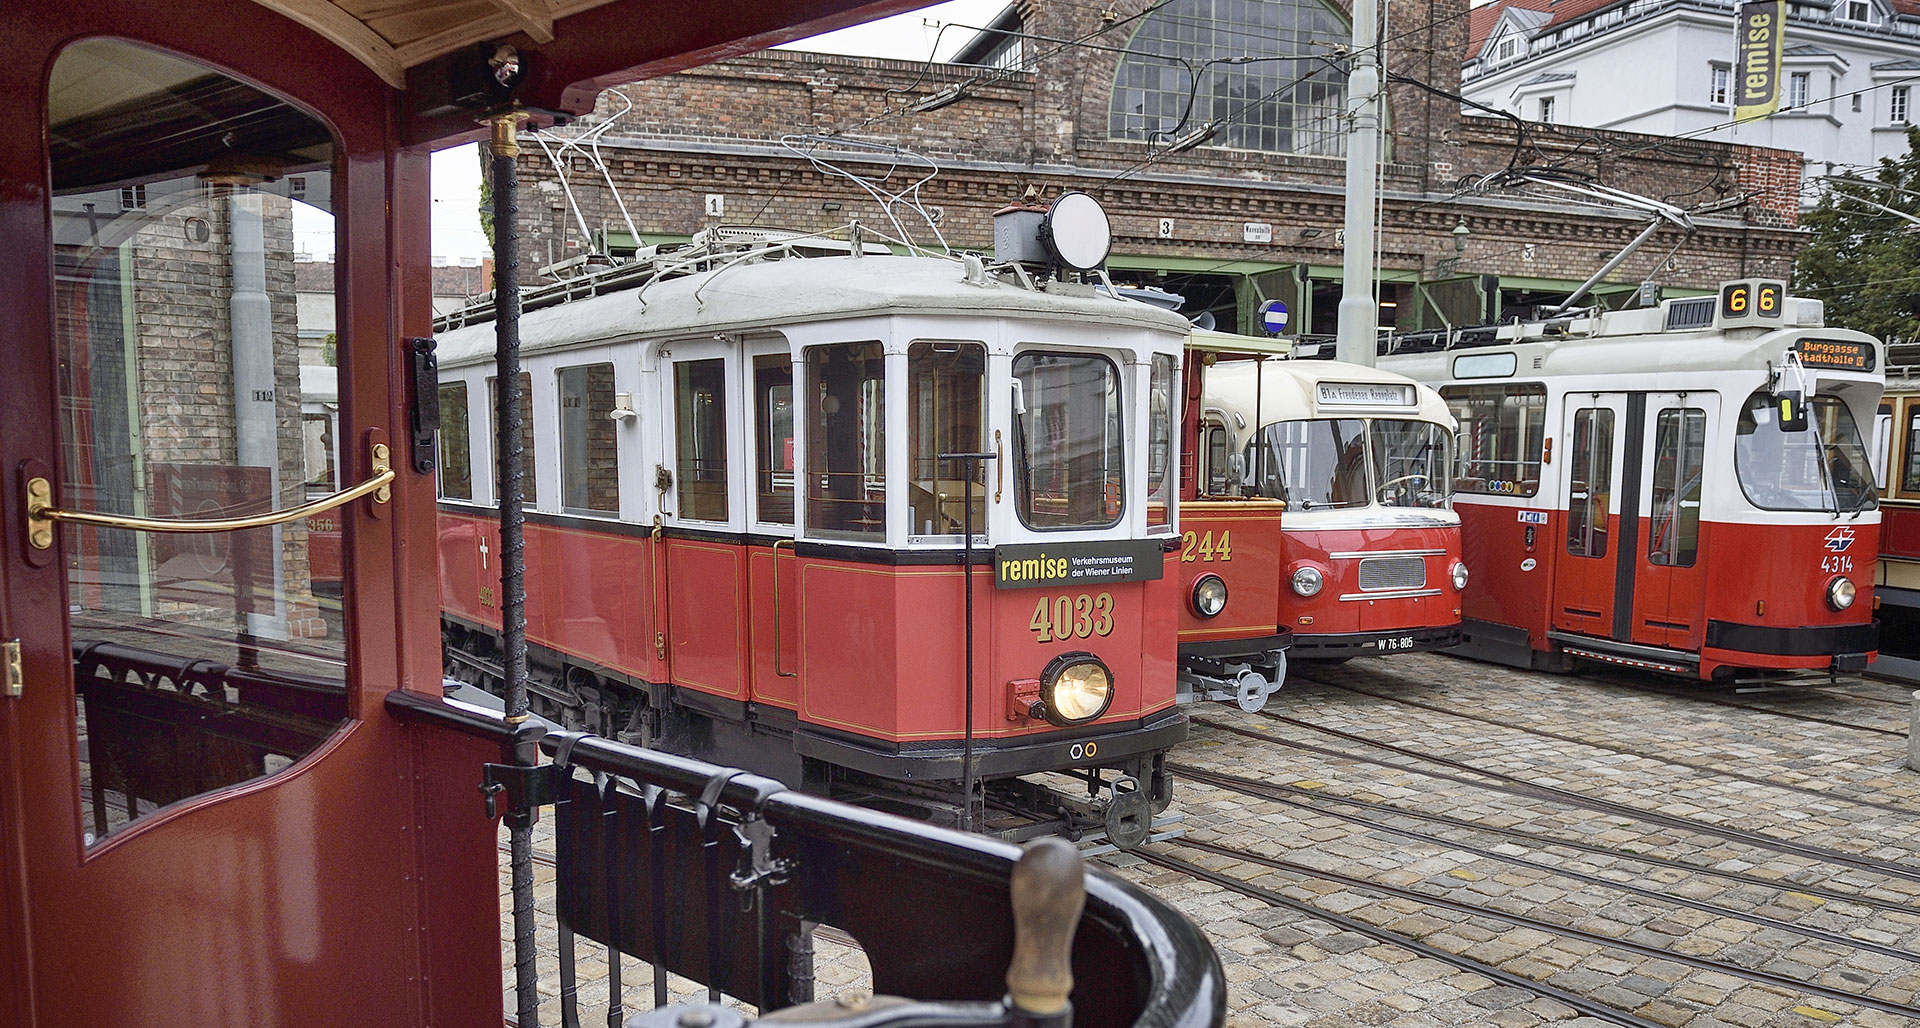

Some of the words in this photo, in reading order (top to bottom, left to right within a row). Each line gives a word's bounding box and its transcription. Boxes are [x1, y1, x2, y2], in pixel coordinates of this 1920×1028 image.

[1741, 13, 1771, 99] remise
[710, 198, 718, 213] 1
[1162, 221, 1170, 235] 3
[1730, 288, 1747, 312] 6
[1760, 288, 1775, 311] 6
[1803, 341, 1859, 354] Burggasse
[255, 390, 273, 402] 112
[1181, 530, 1232, 563] 244
[1001, 553, 1068, 582] remise
[1071, 555, 1133, 566] Verkehrsmuseum
[1071, 569, 1085, 577] der
[1085, 567, 1110, 576] Wiener
[1111, 565, 1133, 575] Linien
[1821, 555, 1853, 573] 4314
[1029, 592, 1115, 643] 4033
[1378, 639, 1387, 650] W
